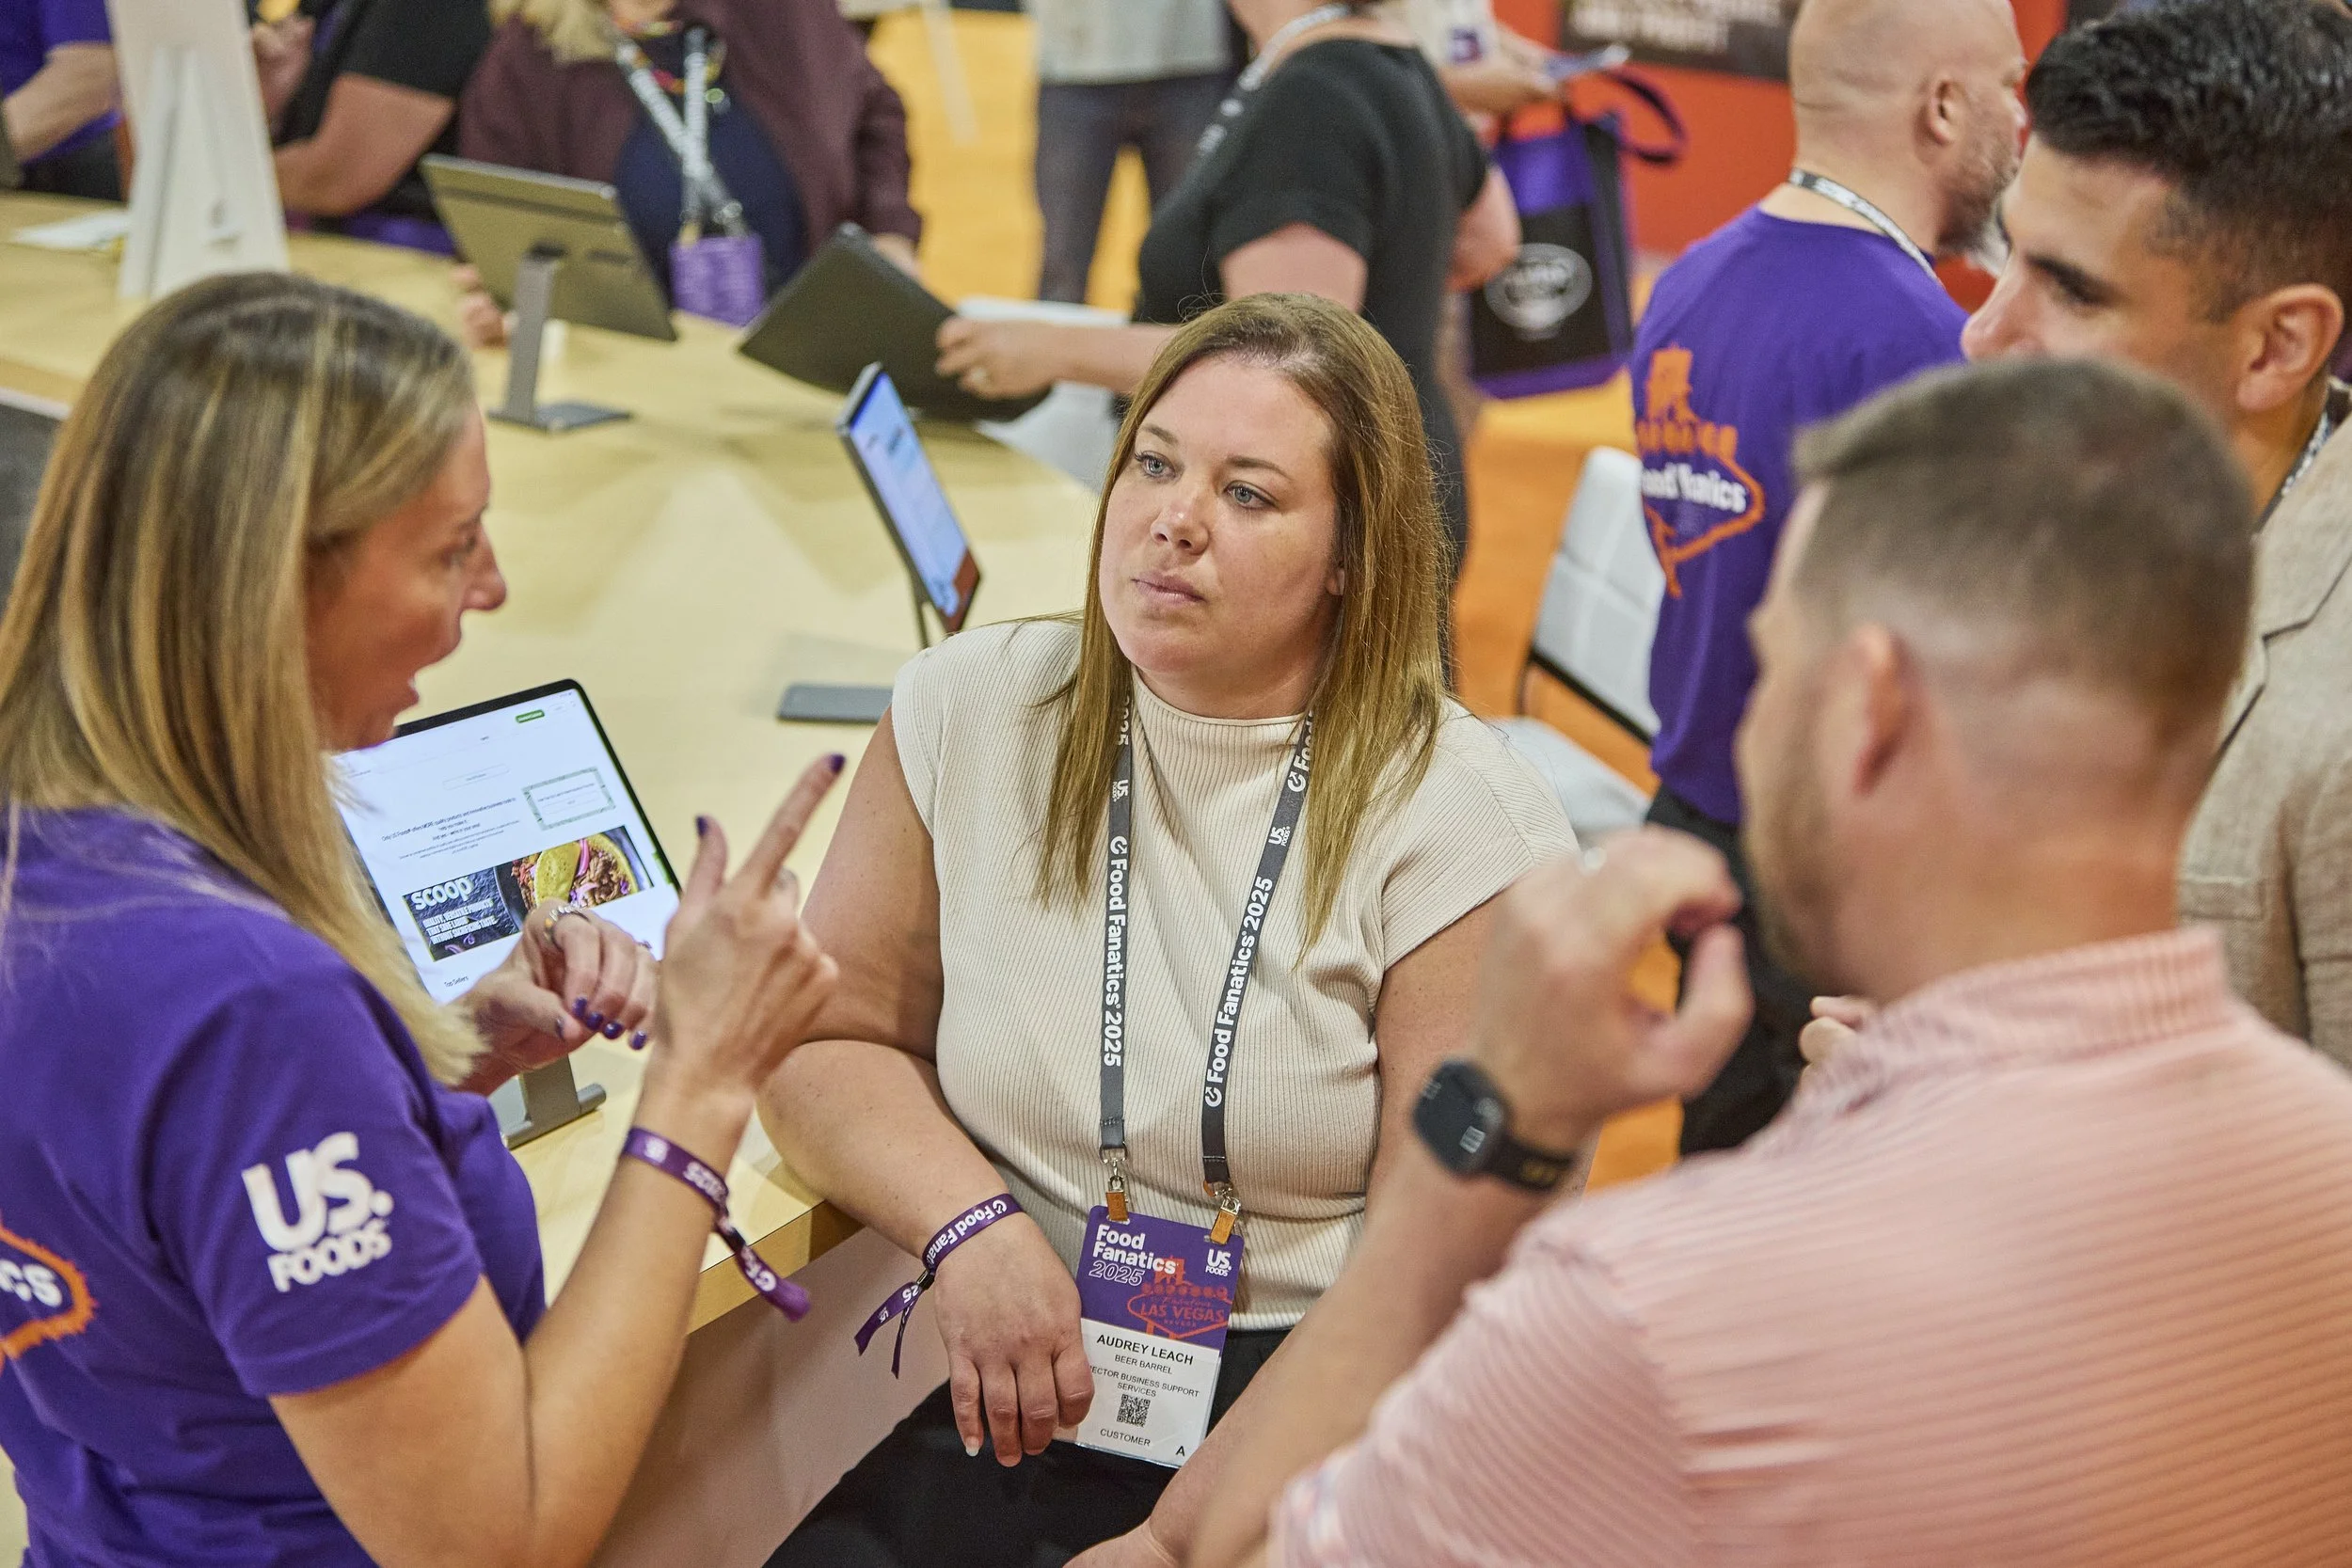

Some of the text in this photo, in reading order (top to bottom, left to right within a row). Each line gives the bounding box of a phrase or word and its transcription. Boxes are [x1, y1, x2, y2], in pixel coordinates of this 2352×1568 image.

[1104, 858, 1128, 1068] Food Fanatics 2025
[1206, 876, 1274, 1084] Food Fanatics 2025
[955, 1206, 995, 1237] Food
[1096, 1224, 1146, 1251] Food
[1092, 1241, 1177, 1275] Fanatics
[1205, 1265, 1229, 1277] FOODS
[1089, 1259, 1146, 1287] 2025
[1140, 1302, 1225, 1323] LAS VEGAS
[1096, 1333, 1195, 1366] AUDREY LEACH
[1114, 1354, 1173, 1375] BEER BARREL
[1089, 1365, 1200, 1398] ECTOR BUSINESS SUPPORT
[1117, 1382, 1157, 1398] SERVICES
[1100, 1428, 1152, 1448] CUSTOMER
[1175, 1446, 1185, 1457] A
